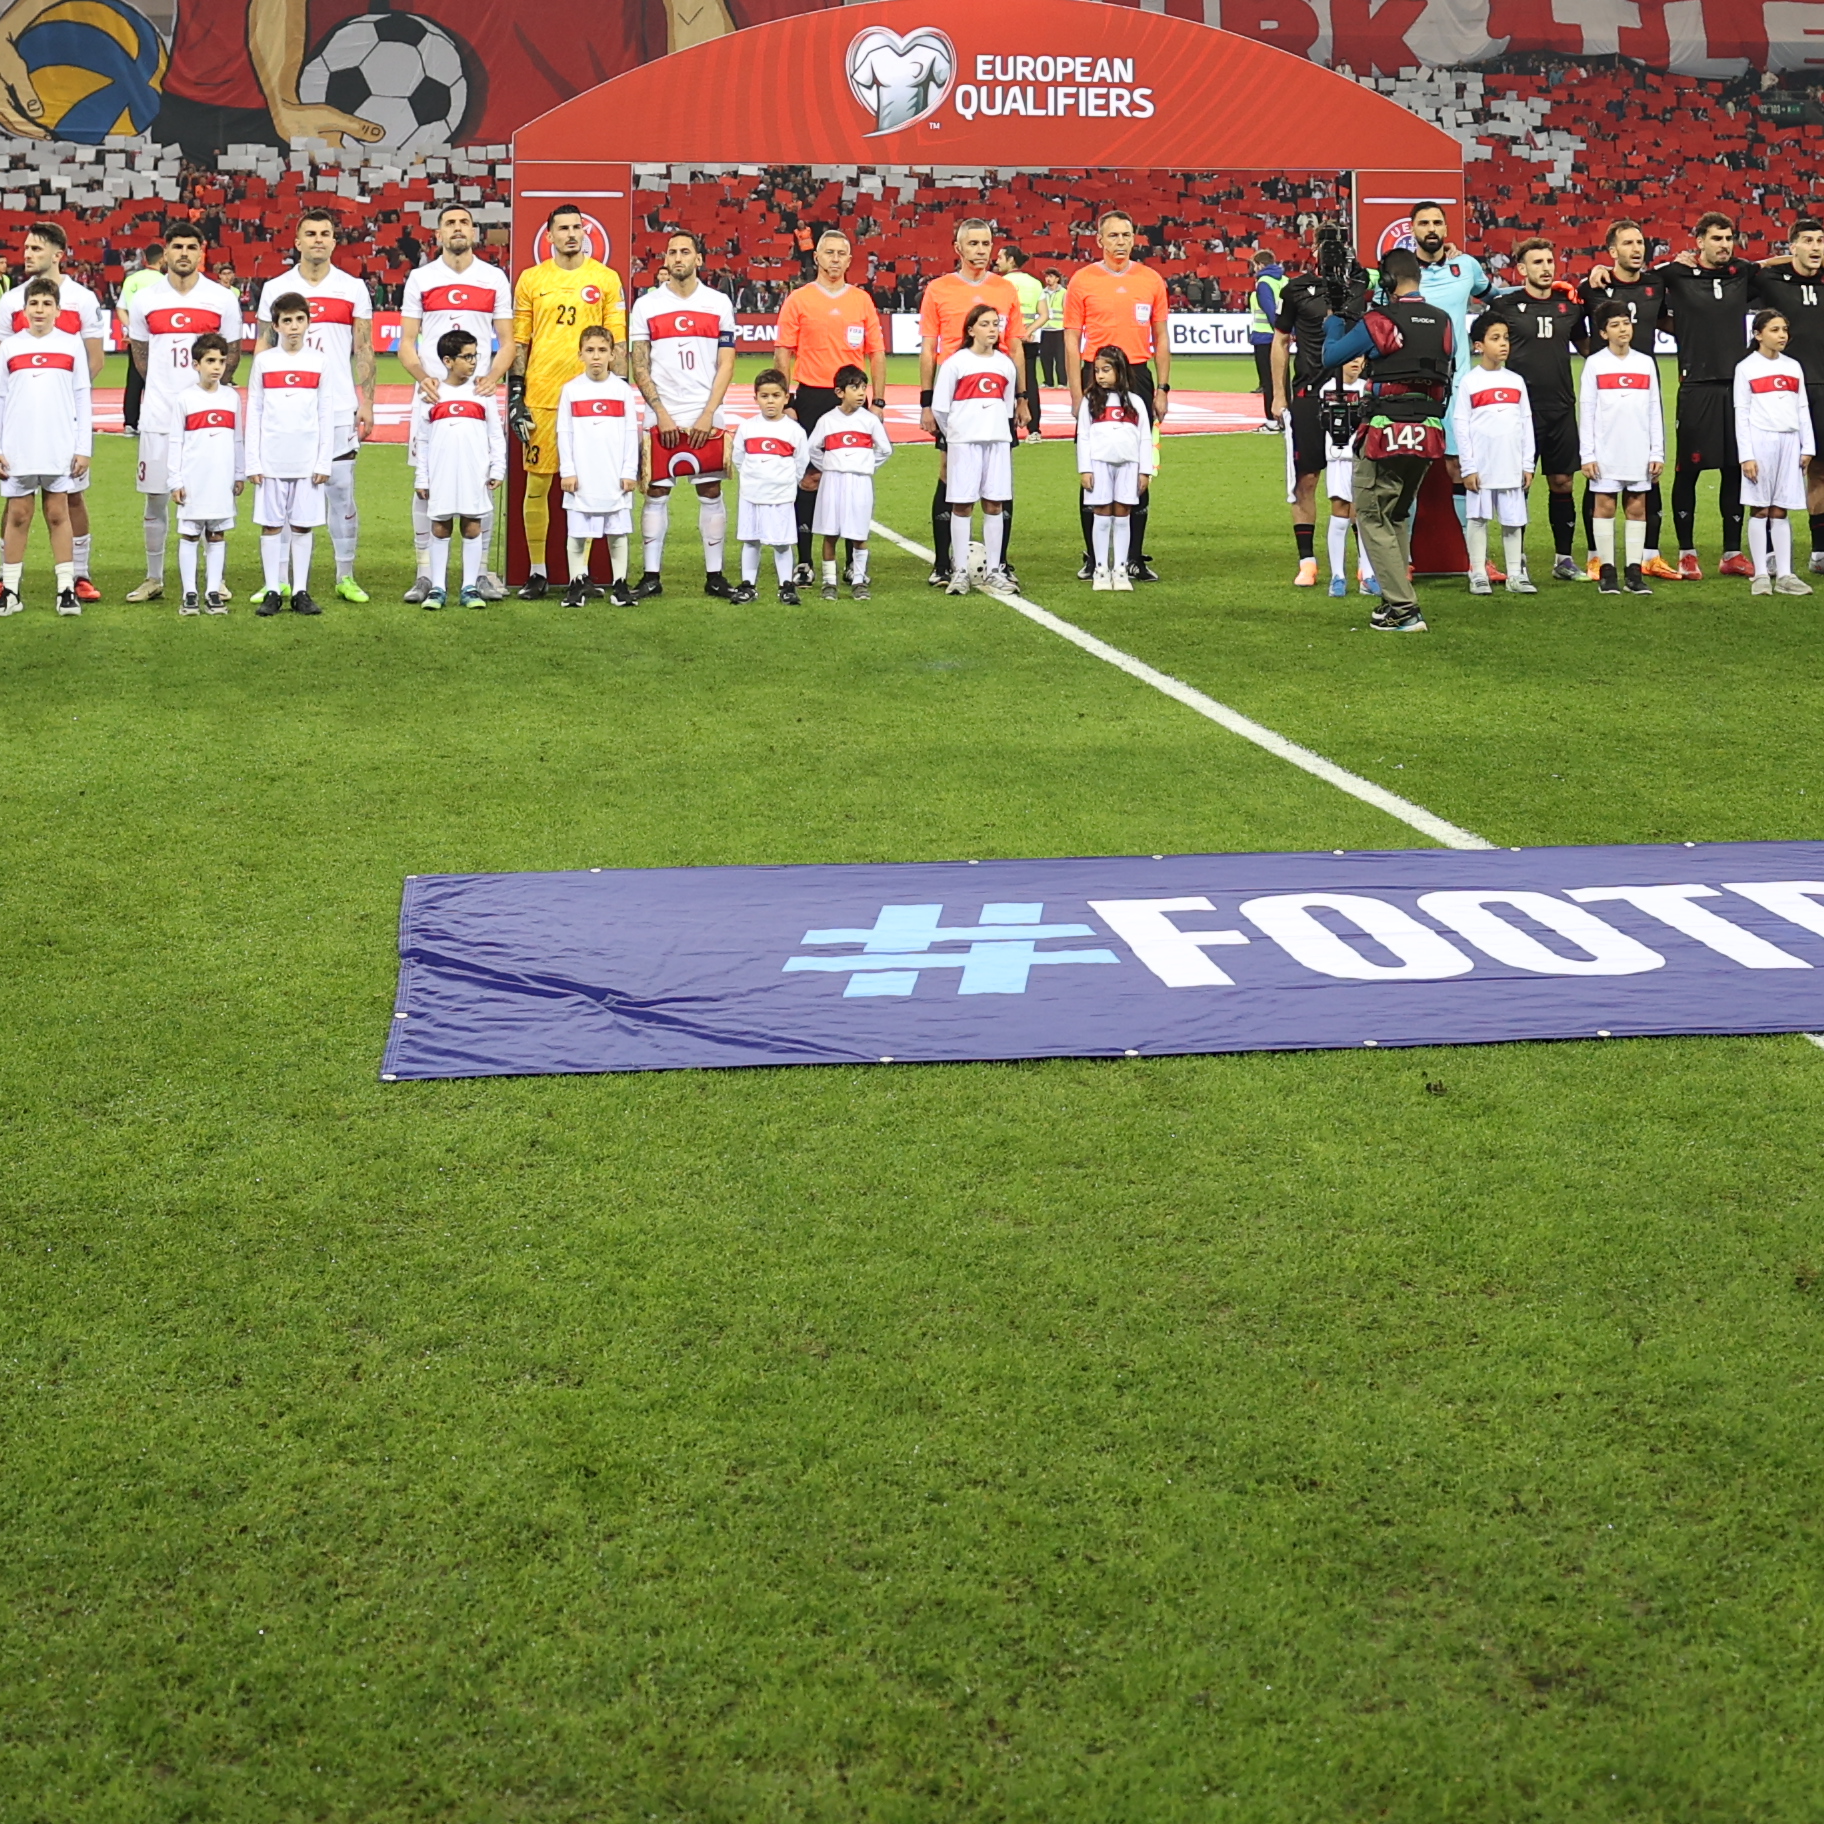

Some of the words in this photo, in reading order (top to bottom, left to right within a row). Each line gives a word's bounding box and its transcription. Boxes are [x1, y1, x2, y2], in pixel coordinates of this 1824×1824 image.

[976, 54, 1134, 83] EUROPEAN
[955, 84, 1155, 121] QUALIFIERS
[1713, 278, 1724, 300] 5
[1800, 284, 1818, 306] 14
[557, 304, 577, 326] 23
[733, 325, 779, 342] PEAN
[1536, 316, 1553, 339] 15
[170, 347, 189, 369] 13
[677, 350, 695, 371] 10
[1384, 425, 1425, 451] 142
[526, 443, 540, 465] 23
